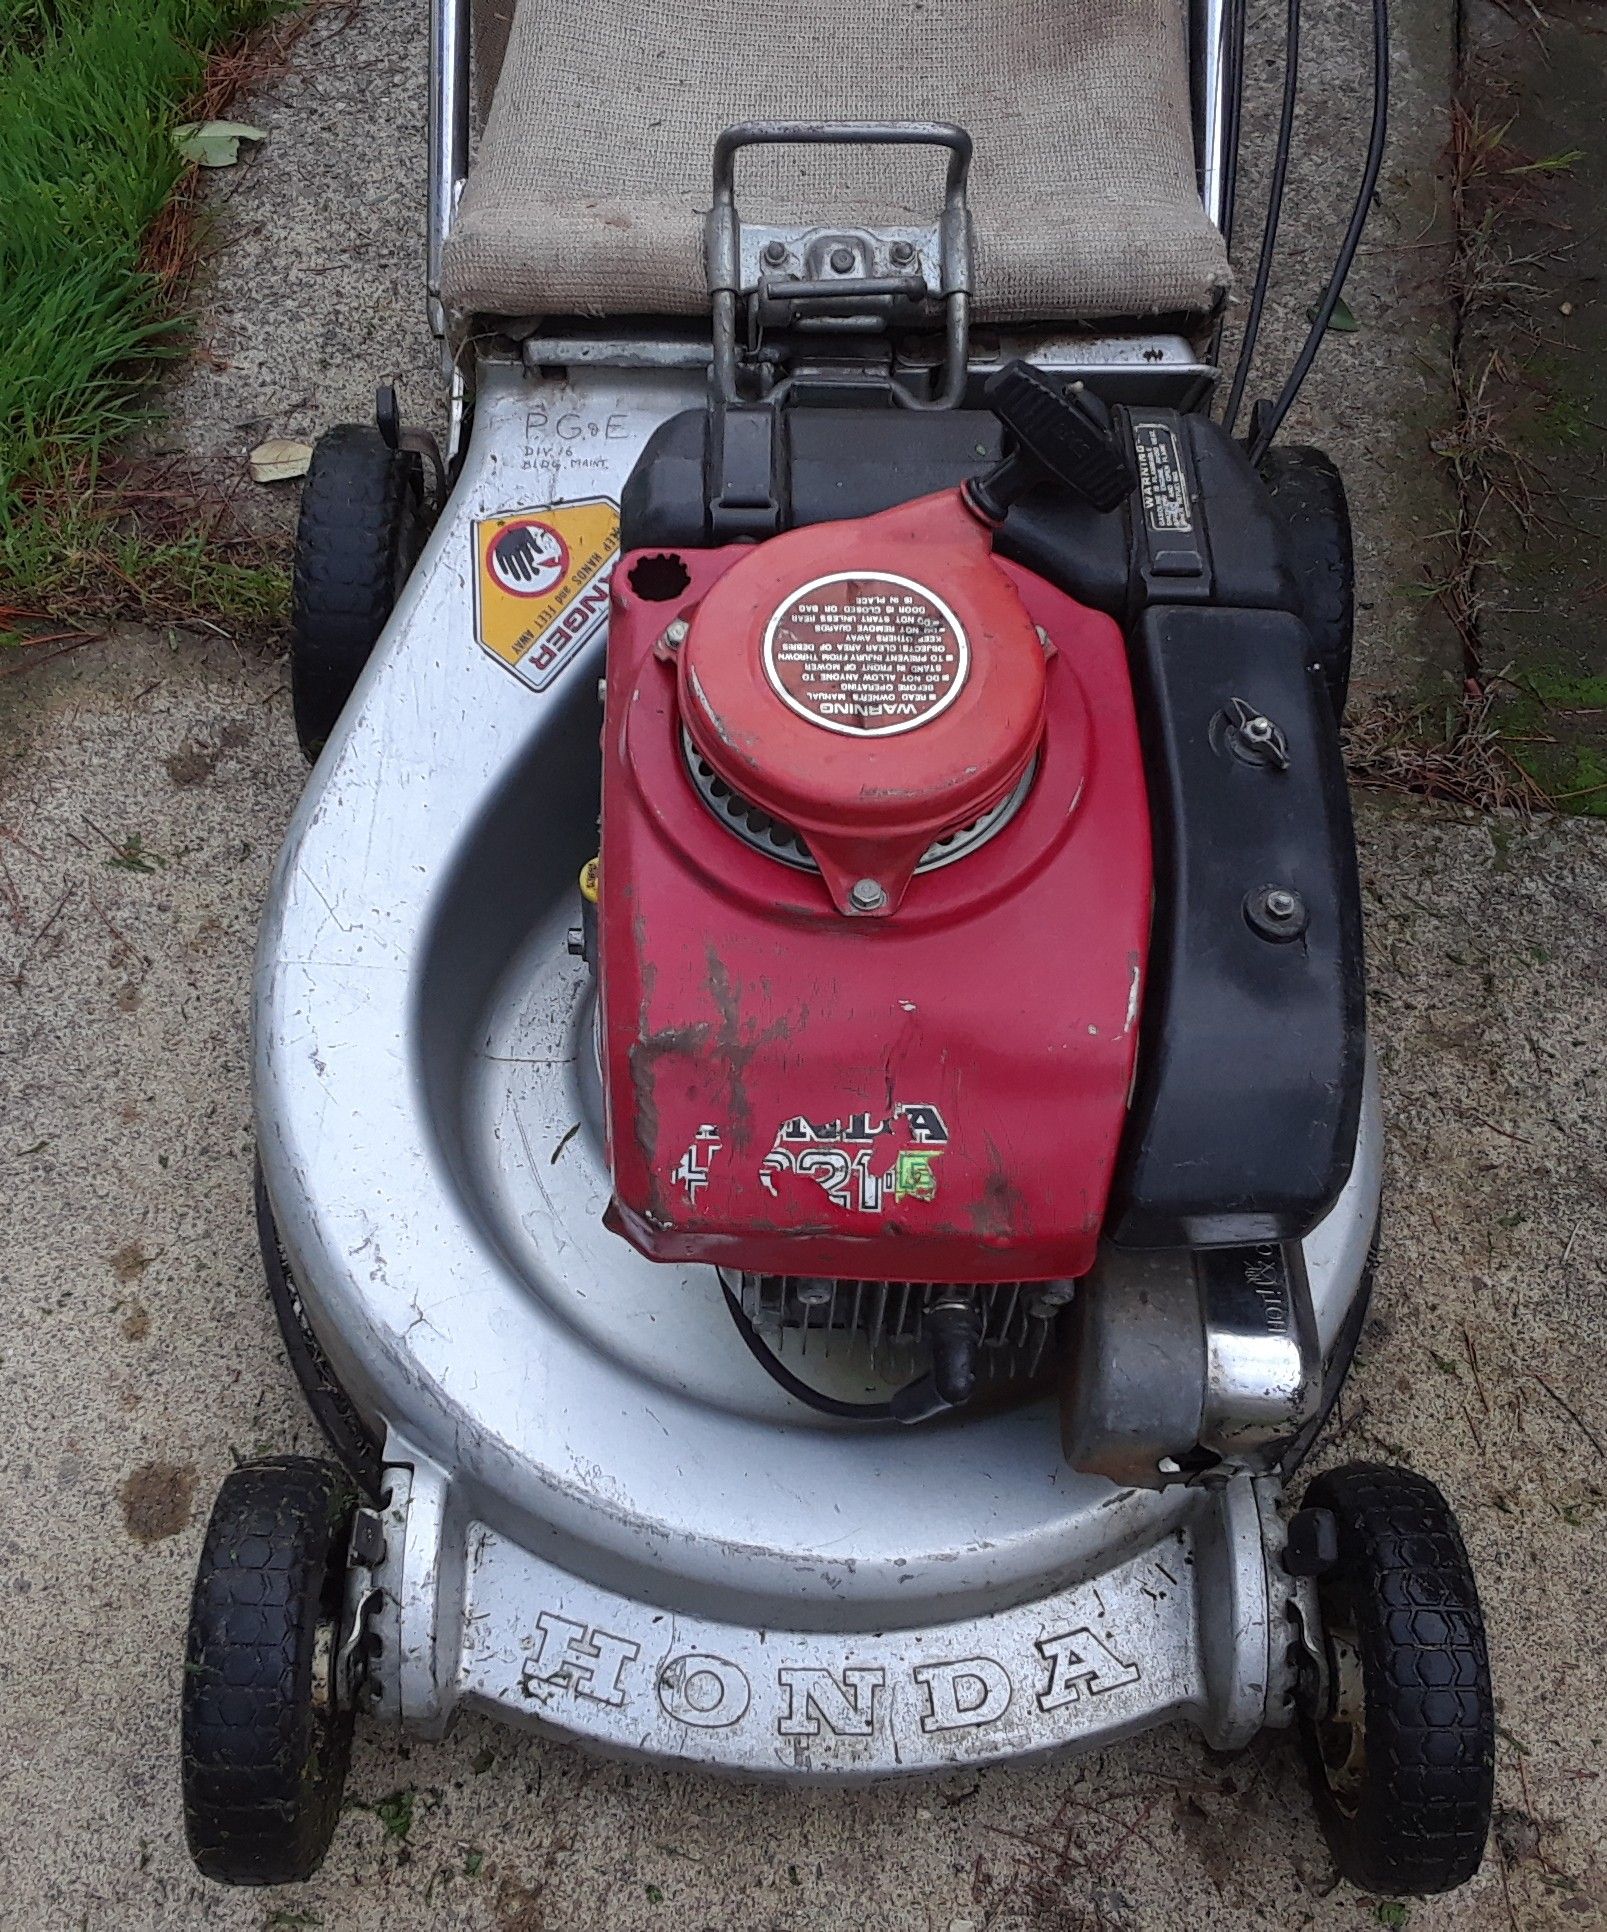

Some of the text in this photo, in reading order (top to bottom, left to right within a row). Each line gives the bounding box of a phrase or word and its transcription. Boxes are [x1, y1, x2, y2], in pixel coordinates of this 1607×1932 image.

[1136, 445, 1154, 509] WARNING
[572, 555, 602, 586] HANDS
[554, 586, 571, 605] and
[825, 605, 837, 613] OR
[899, 606, 925, 614] DOOR
[534, 604, 557, 630] FEET
[861, 615, 890, 623] START
[896, 615, 914, 623] NOT
[917, 617, 931, 626] DO
[815, 624, 851, 632] GUARDS
[900, 625, 919, 633] NOT
[511, 629, 535, 655] AWAY
[845, 634, 871, 642] AWAY
[866, 644, 896, 652] CLEAR
[822, 653, 848, 661] FROM
[930, 654, 943, 662] TO
[805, 663, 840, 671] MOWER
[821, 673, 858, 681] ANYONE
[806, 692, 845, 700] MANUAL
[902, 693, 926, 701] READ
[819, 703, 917, 715] WARNING
[523, 1610, 1141, 1736] HONDA
